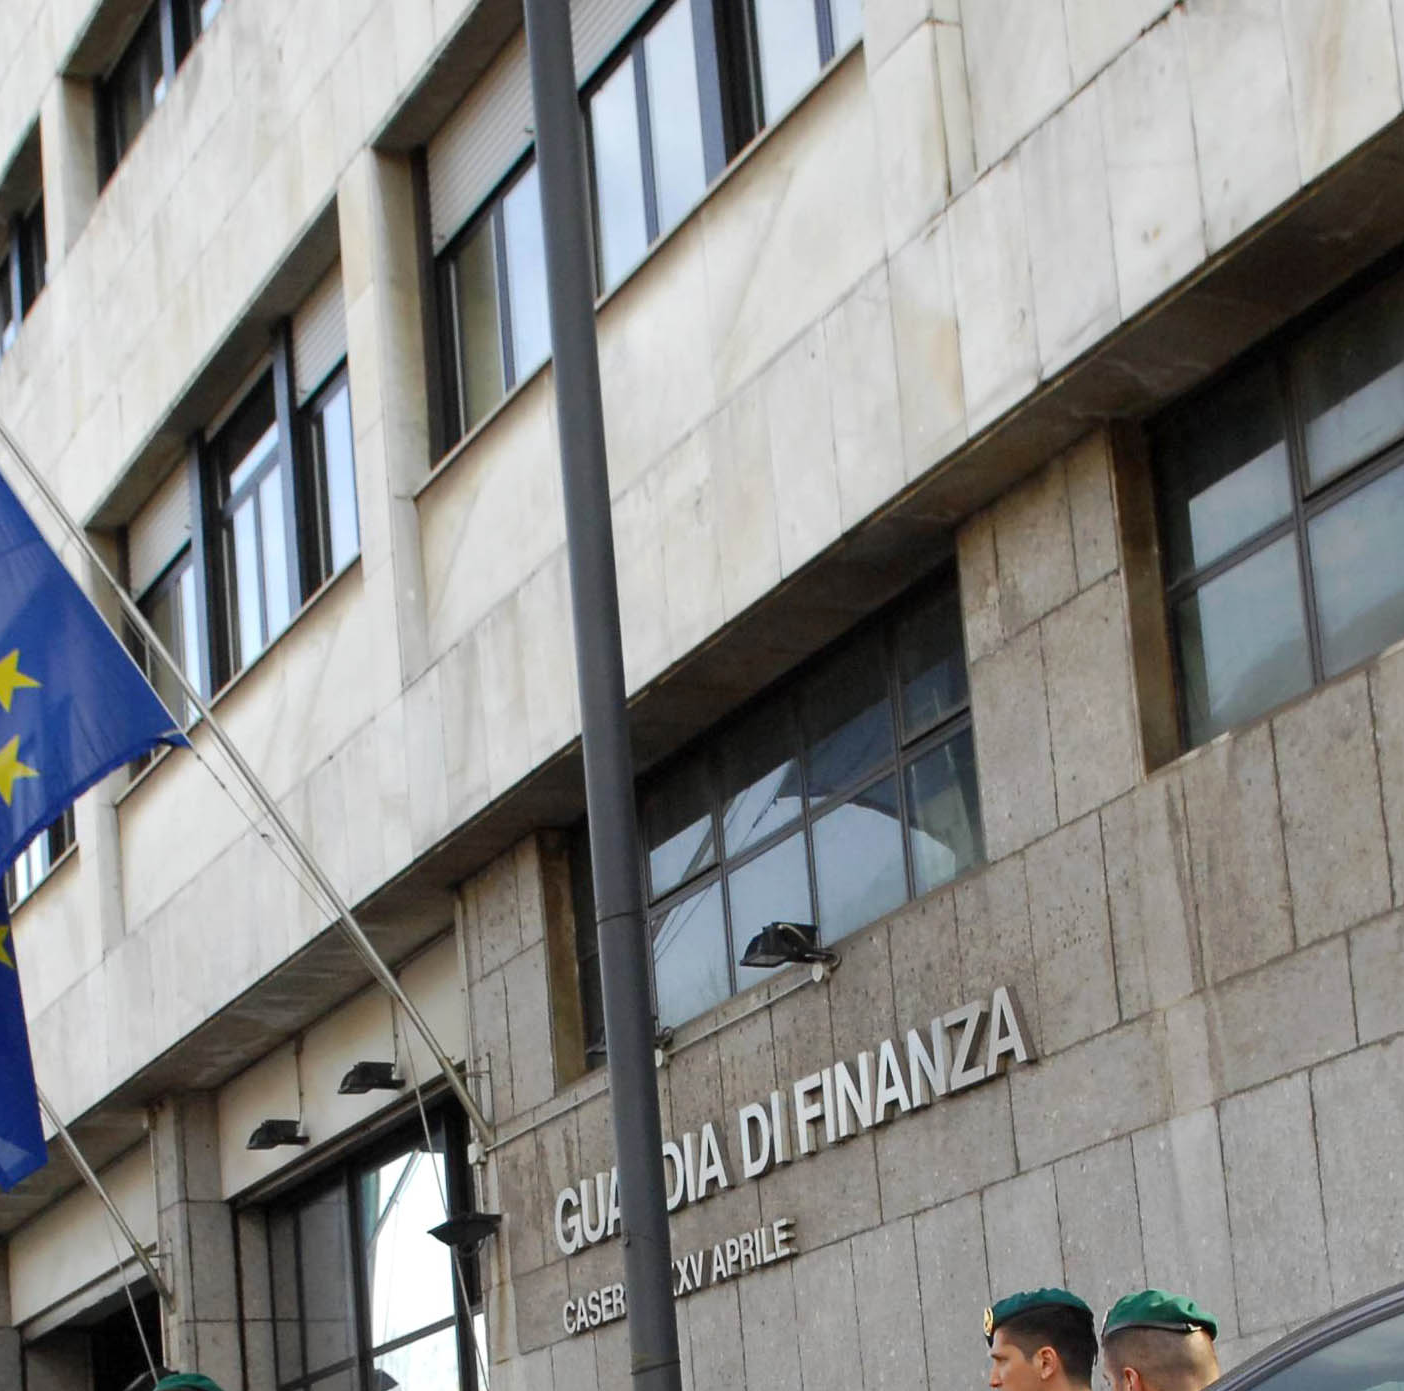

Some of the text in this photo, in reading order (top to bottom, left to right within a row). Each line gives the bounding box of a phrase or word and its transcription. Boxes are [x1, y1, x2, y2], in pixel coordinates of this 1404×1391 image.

[738, 1088, 792, 1182] DI
[795, 985, 1035, 1156] FINANZA
[672, 1250, 709, 1297] XV
[712, 1217, 796, 1283] APRILE
